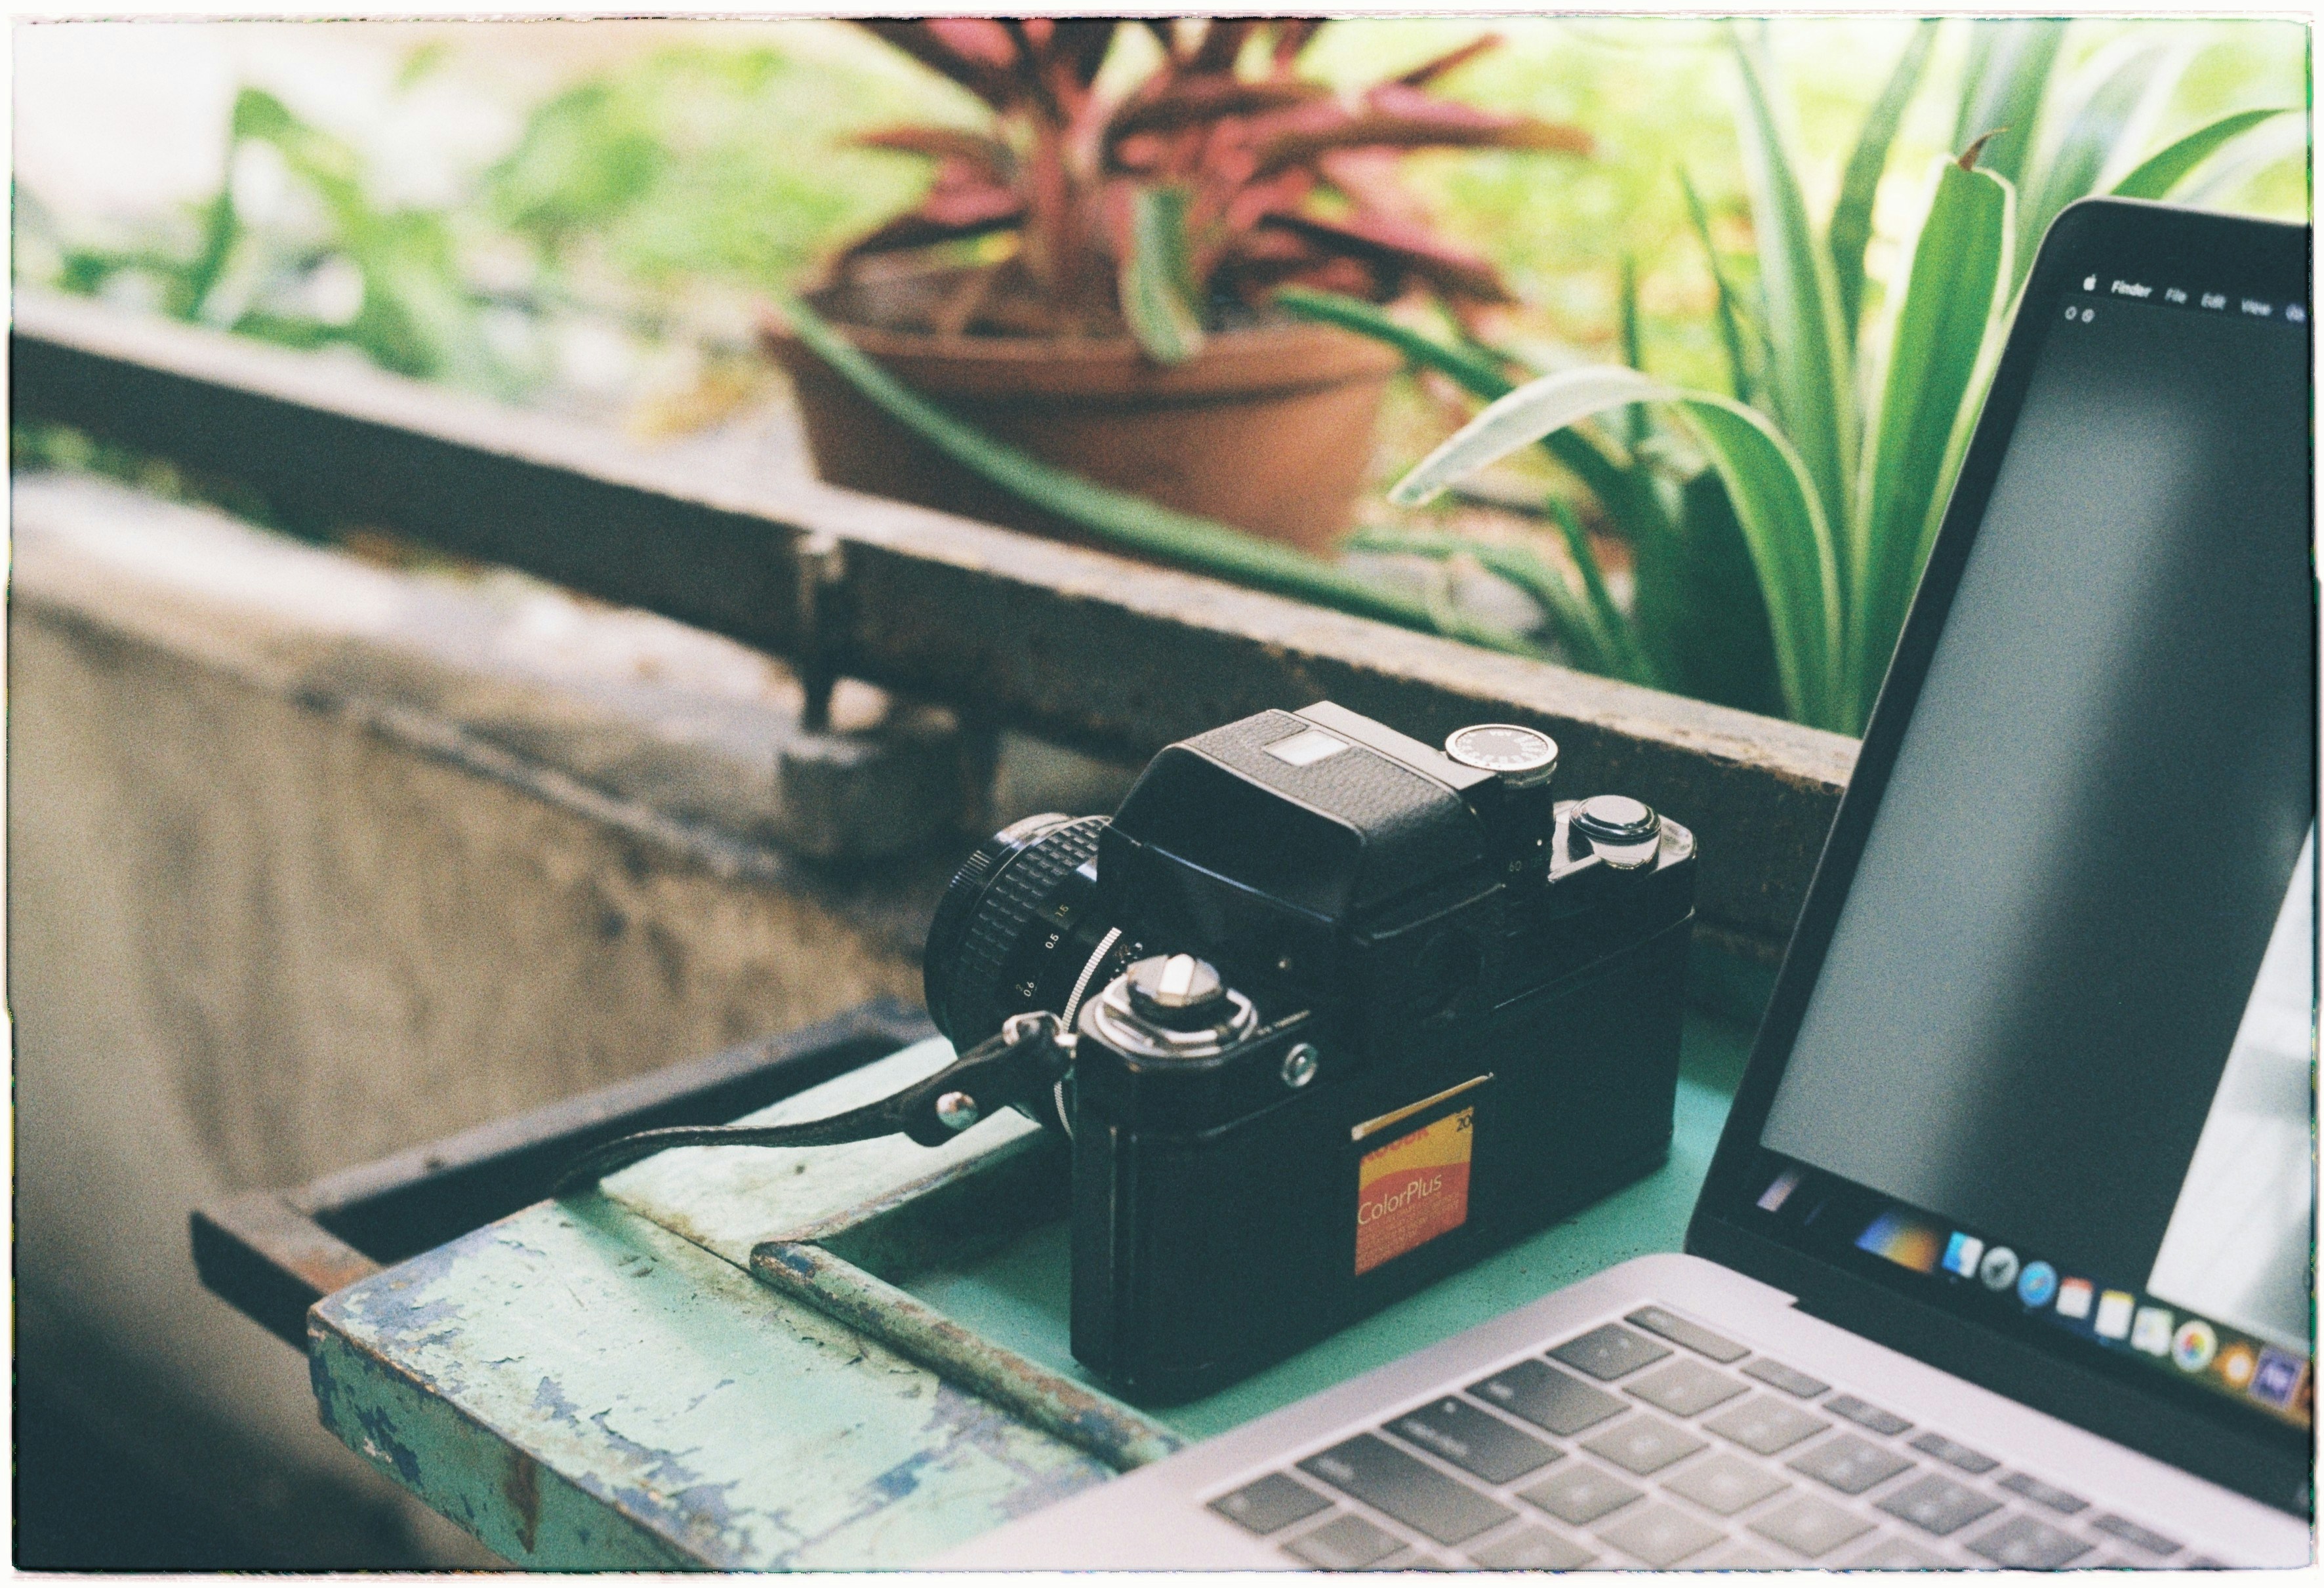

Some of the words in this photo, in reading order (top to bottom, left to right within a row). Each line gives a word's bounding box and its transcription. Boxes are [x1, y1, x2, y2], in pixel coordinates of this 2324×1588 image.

[2110, 279, 2153, 298] Finder
[1509, 860, 1522, 872] 60
[1023, 981, 1035, 997] 0.6
[1358, 1173, 1442, 1225] ColorPlus
